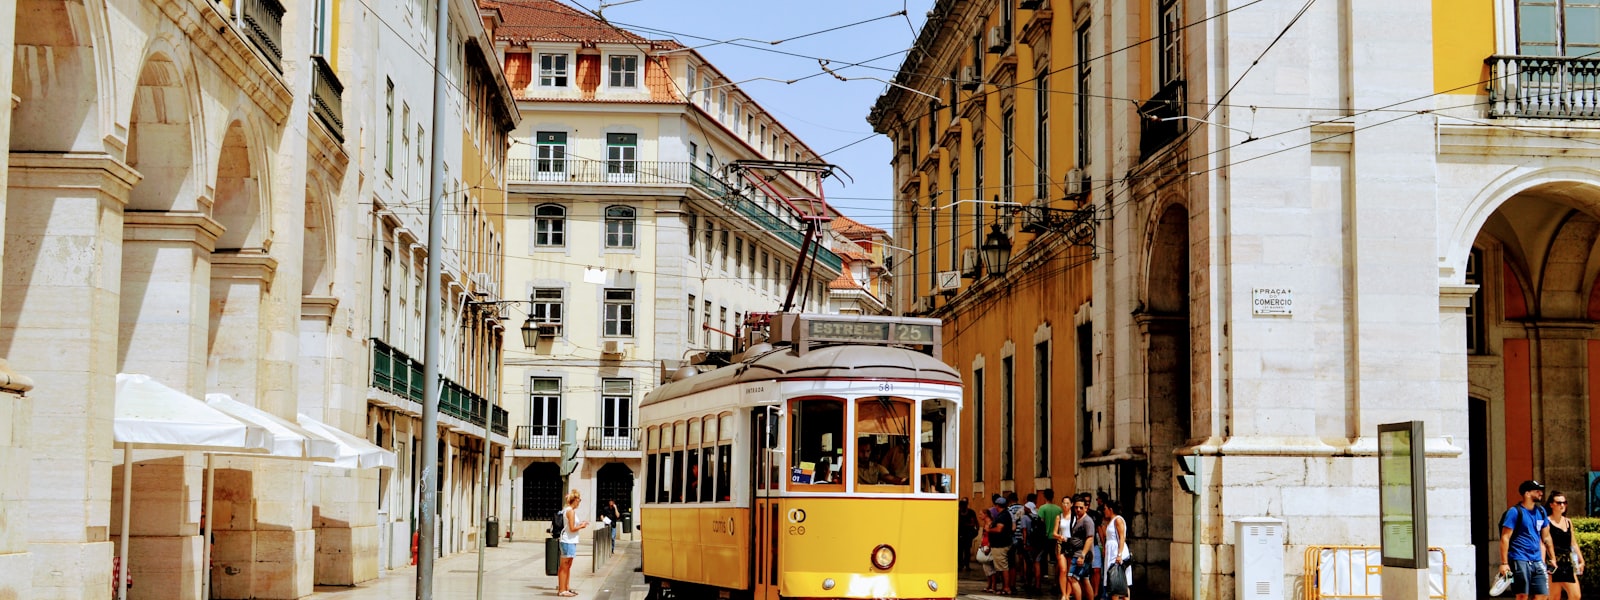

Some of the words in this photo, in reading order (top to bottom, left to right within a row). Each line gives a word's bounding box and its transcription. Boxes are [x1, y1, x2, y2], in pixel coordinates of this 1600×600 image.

[813, 322, 883, 336] ESTRELA
[898, 325, 921, 340] 25
[878, 383, 894, 391] 581
